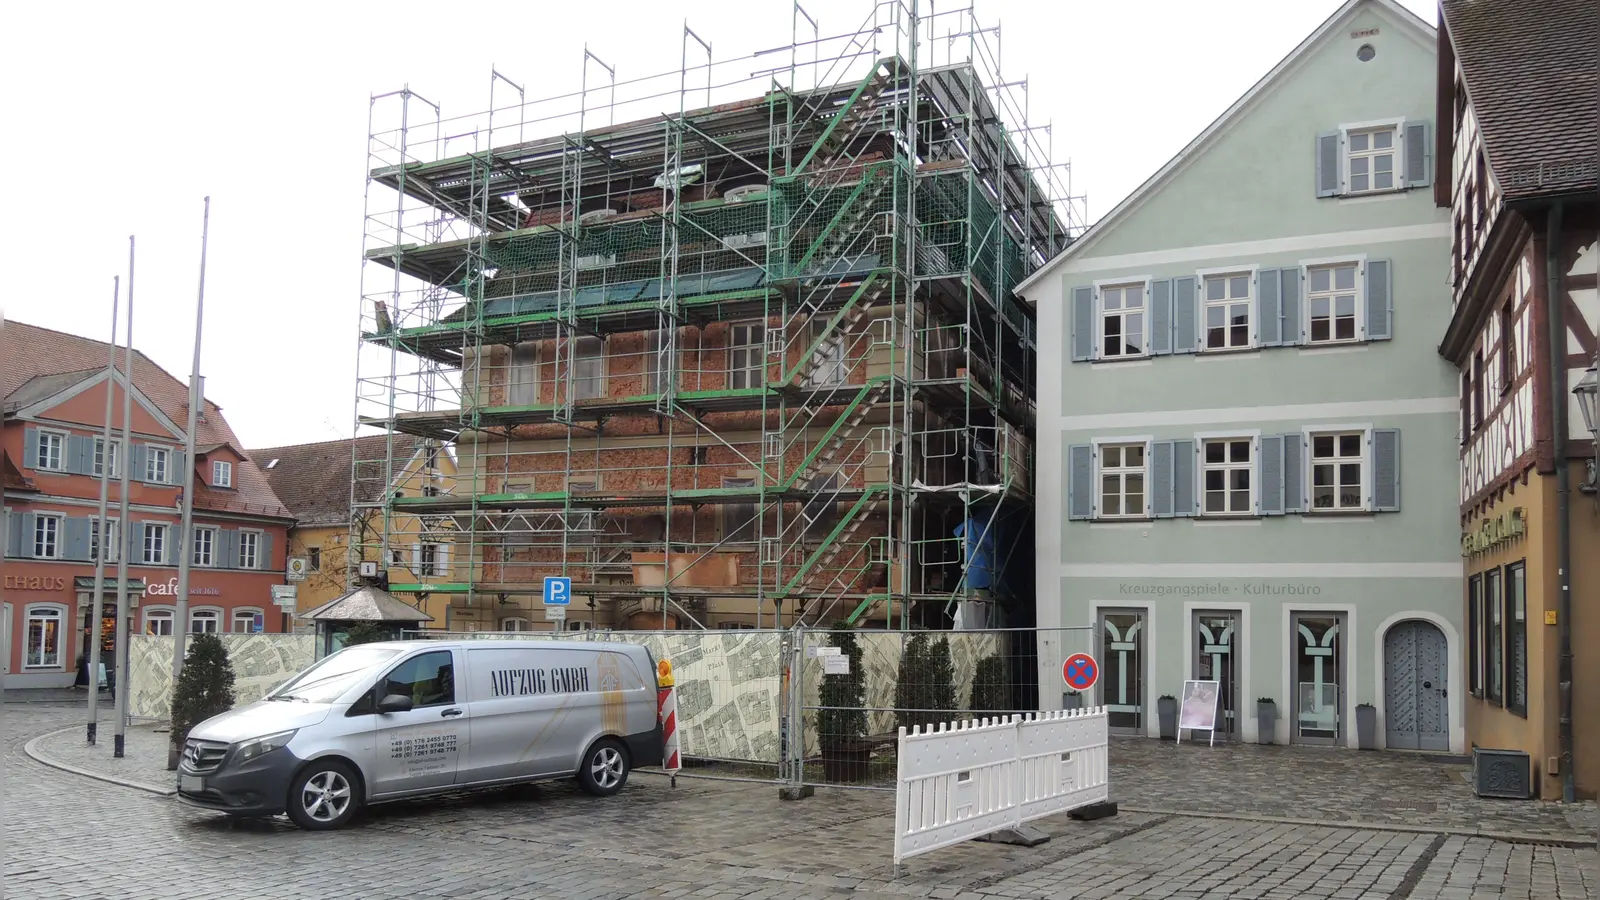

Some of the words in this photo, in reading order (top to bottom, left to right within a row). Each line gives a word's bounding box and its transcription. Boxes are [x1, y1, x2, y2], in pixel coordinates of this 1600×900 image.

[550, 580, 565, 601] P
[1119, 583, 1229, 597] Kreuzgangspiele
[1243, 583, 1321, 596] Kulturbüro
[491, 668, 547, 697] AUFZUG
[551, 667, 590, 694] GMBH
